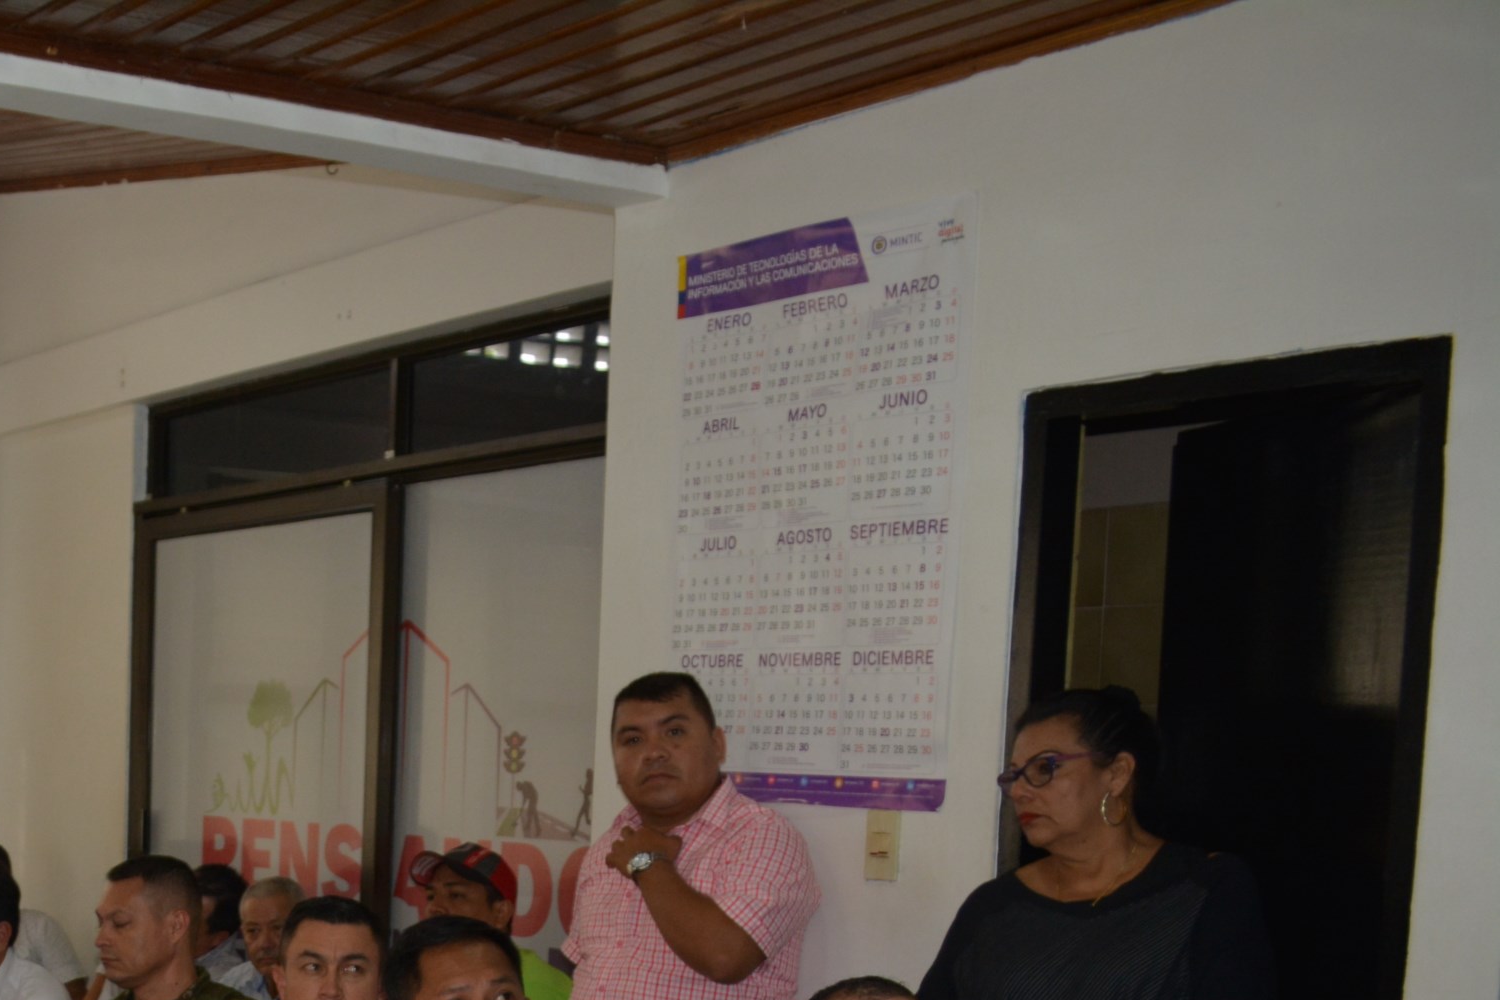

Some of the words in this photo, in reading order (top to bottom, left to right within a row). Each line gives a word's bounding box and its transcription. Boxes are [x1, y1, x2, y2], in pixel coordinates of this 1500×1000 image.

[890, 231, 923, 247] MINTIC
[688, 266, 736, 287] MINISTERIO
[736, 264, 748, 276] DE
[749, 249, 807, 271] TECNOLOGÍAS
[808, 245, 824, 258] DE
[825, 242, 840, 255] LA
[748, 276, 755, 289] Y
[755, 273, 771, 286] LAS
[772, 254, 859, 281] COMUNICACIONES
[885, 274, 940, 299] MARZO
[782, 293, 848, 319] FEBRERO
[707, 312, 752, 333] ENERO
[879, 389, 928, 410] JUNIO
[788, 403, 827, 422] MAYO
[703, 417, 740, 434] ABRIL
[777, 527, 832, 545] AGOSTO
[850, 518, 949, 540] SEPTIEMBRE
[700, 536, 737, 552] JULIO
[681, 653, 744, 668] OCTUBRE
[759, 651, 841, 667] NOVIEMBRE
[852, 649, 934, 666] DICIEMBRE
